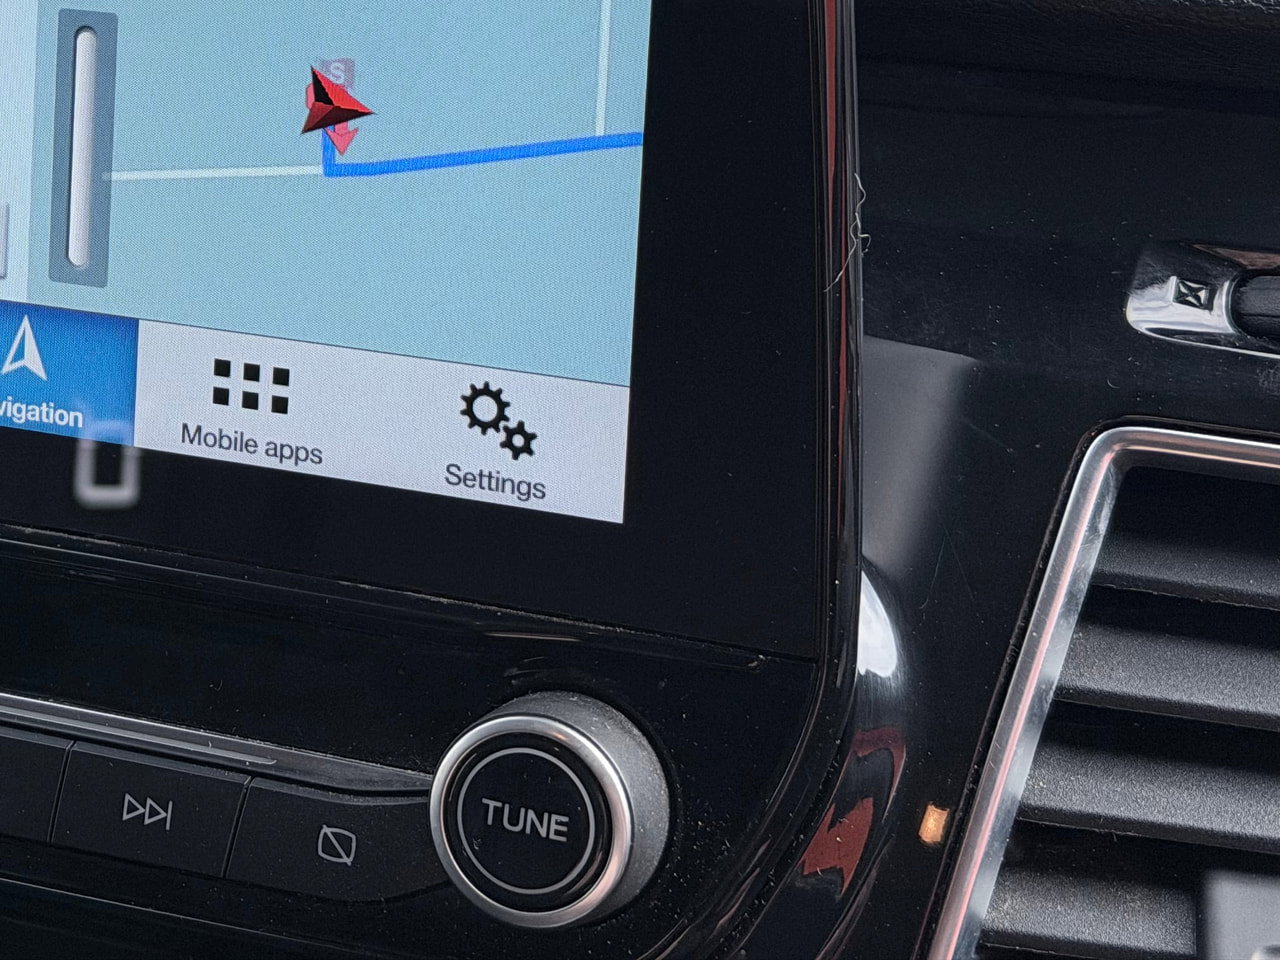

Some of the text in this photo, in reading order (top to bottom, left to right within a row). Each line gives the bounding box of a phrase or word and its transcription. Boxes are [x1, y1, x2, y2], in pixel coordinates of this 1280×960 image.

[181, 422, 323, 466] Mobile apps
[444, 463, 547, 501] Settings
[481, 798, 570, 842] TUNE
